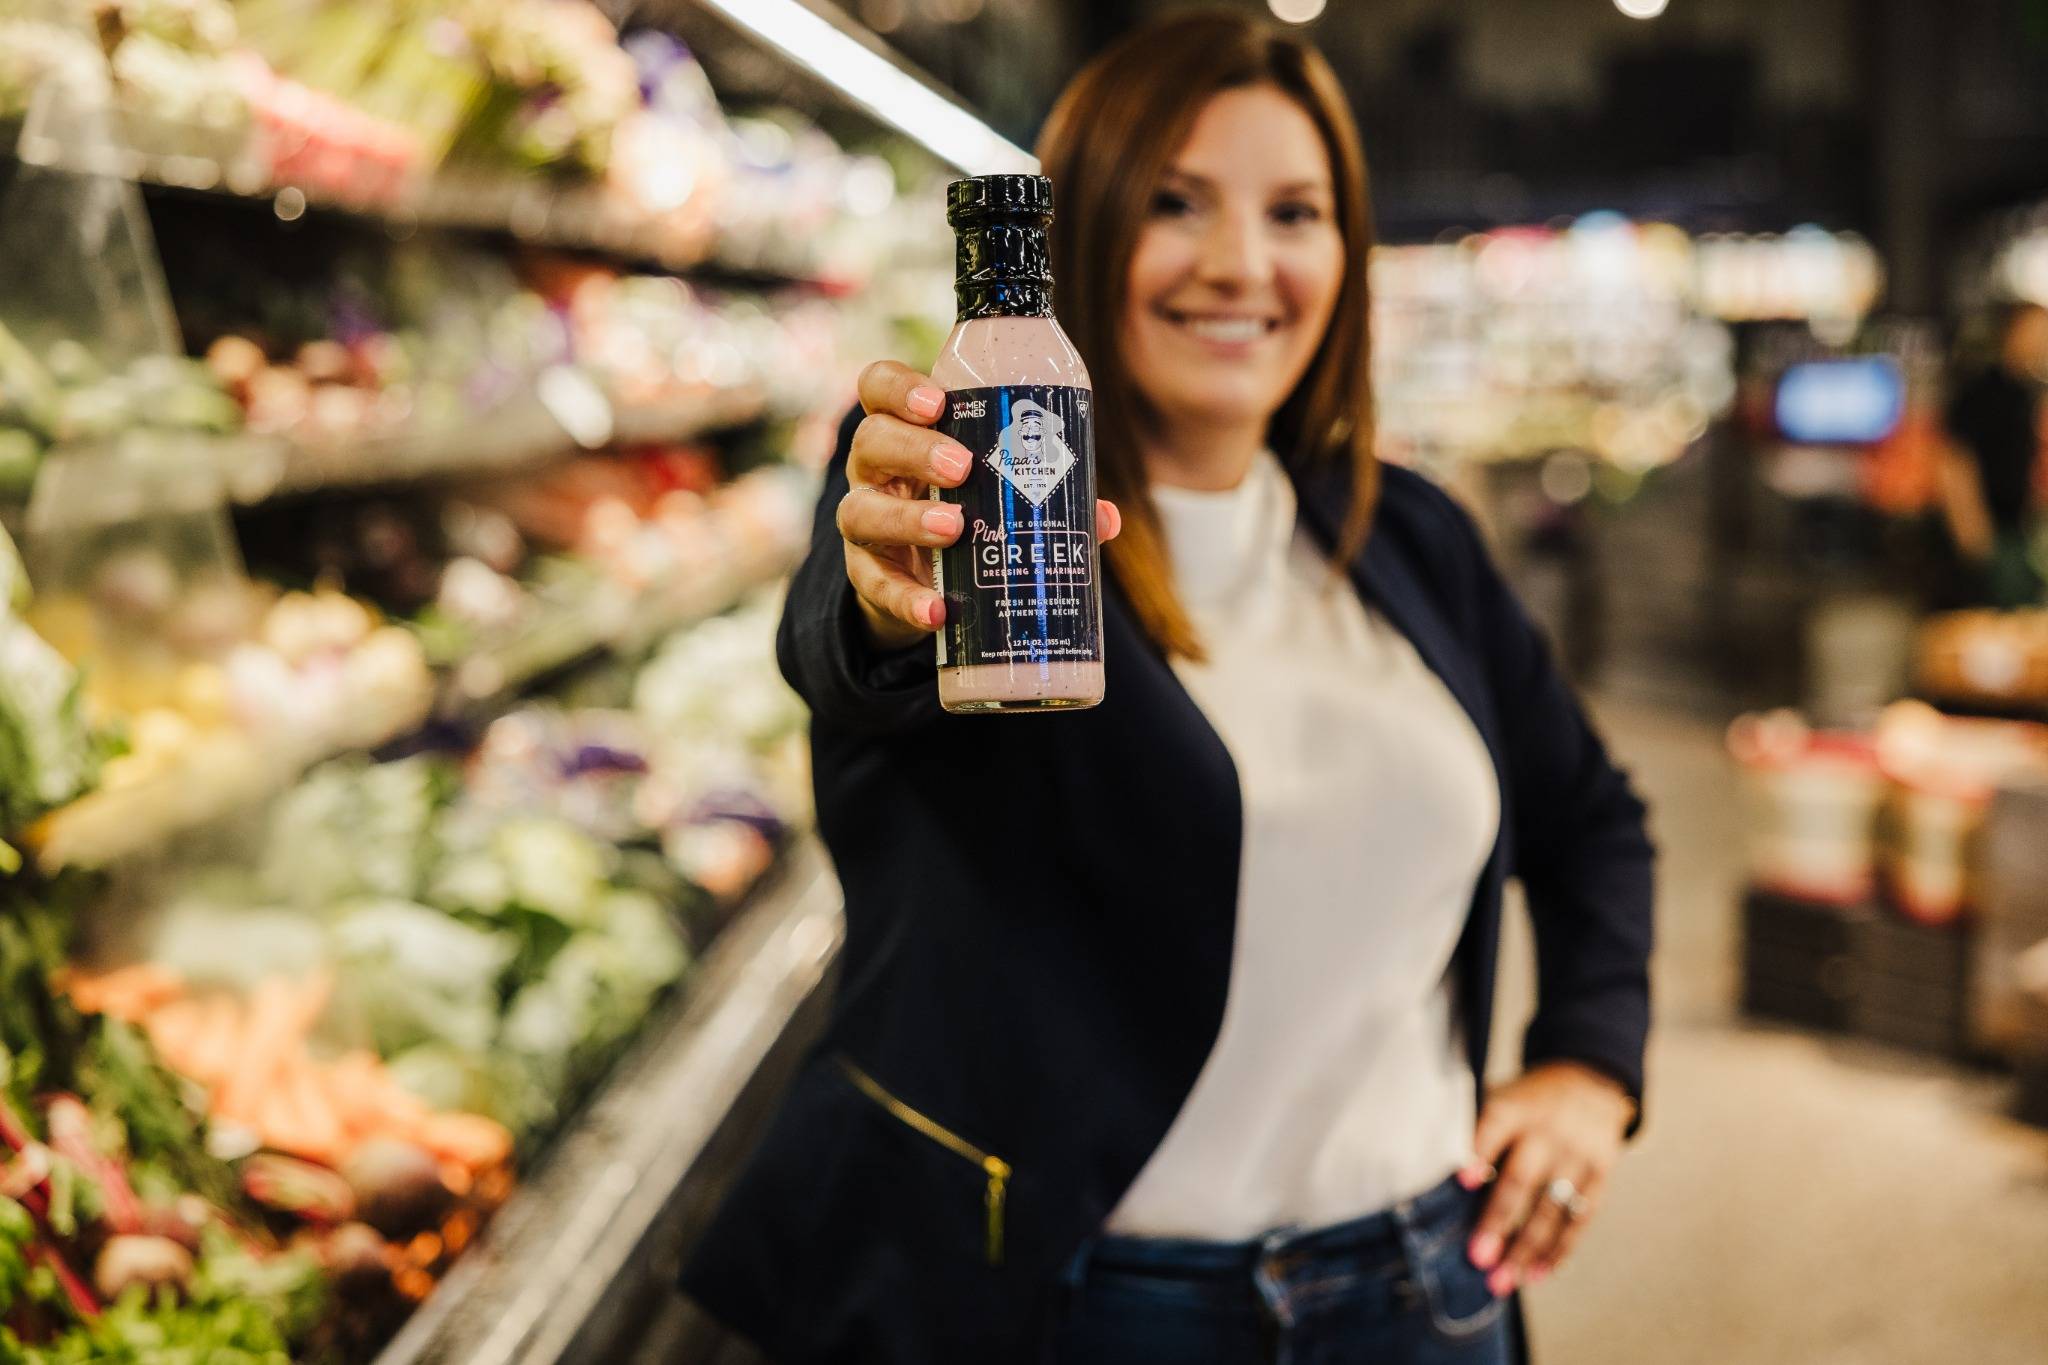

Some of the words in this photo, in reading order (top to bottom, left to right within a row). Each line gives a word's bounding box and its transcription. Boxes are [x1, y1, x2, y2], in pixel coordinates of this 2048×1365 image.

[953, 400, 986, 411] WOMEN
[953, 409, 986, 420] OWNED
[998, 449, 1042, 471] Papa's
[1014, 467, 1056, 476] KITCHEN
[1006, 521, 1024, 529] THE
[1028, 520, 1068, 528] ORIGINAL
[972, 519, 1009, 544] Pink
[982, 543, 1085, 566] GREEK
[983, 567, 1030, 577] DRESSING
[1033, 567, 1042, 576] &
[1045, 566, 1086, 576] MARINADE
[995, 599, 1024, 608] FRESH
[1027, 597, 1081, 607] INGREDIENTS
[998, 608, 1049, 618] AUTHENTIC
[1052, 607, 1079, 616] RECIPE
[1059, 638, 1071, 647] mL)
[981, 650, 996, 659] Keep
[1053, 647, 1066, 655] well
